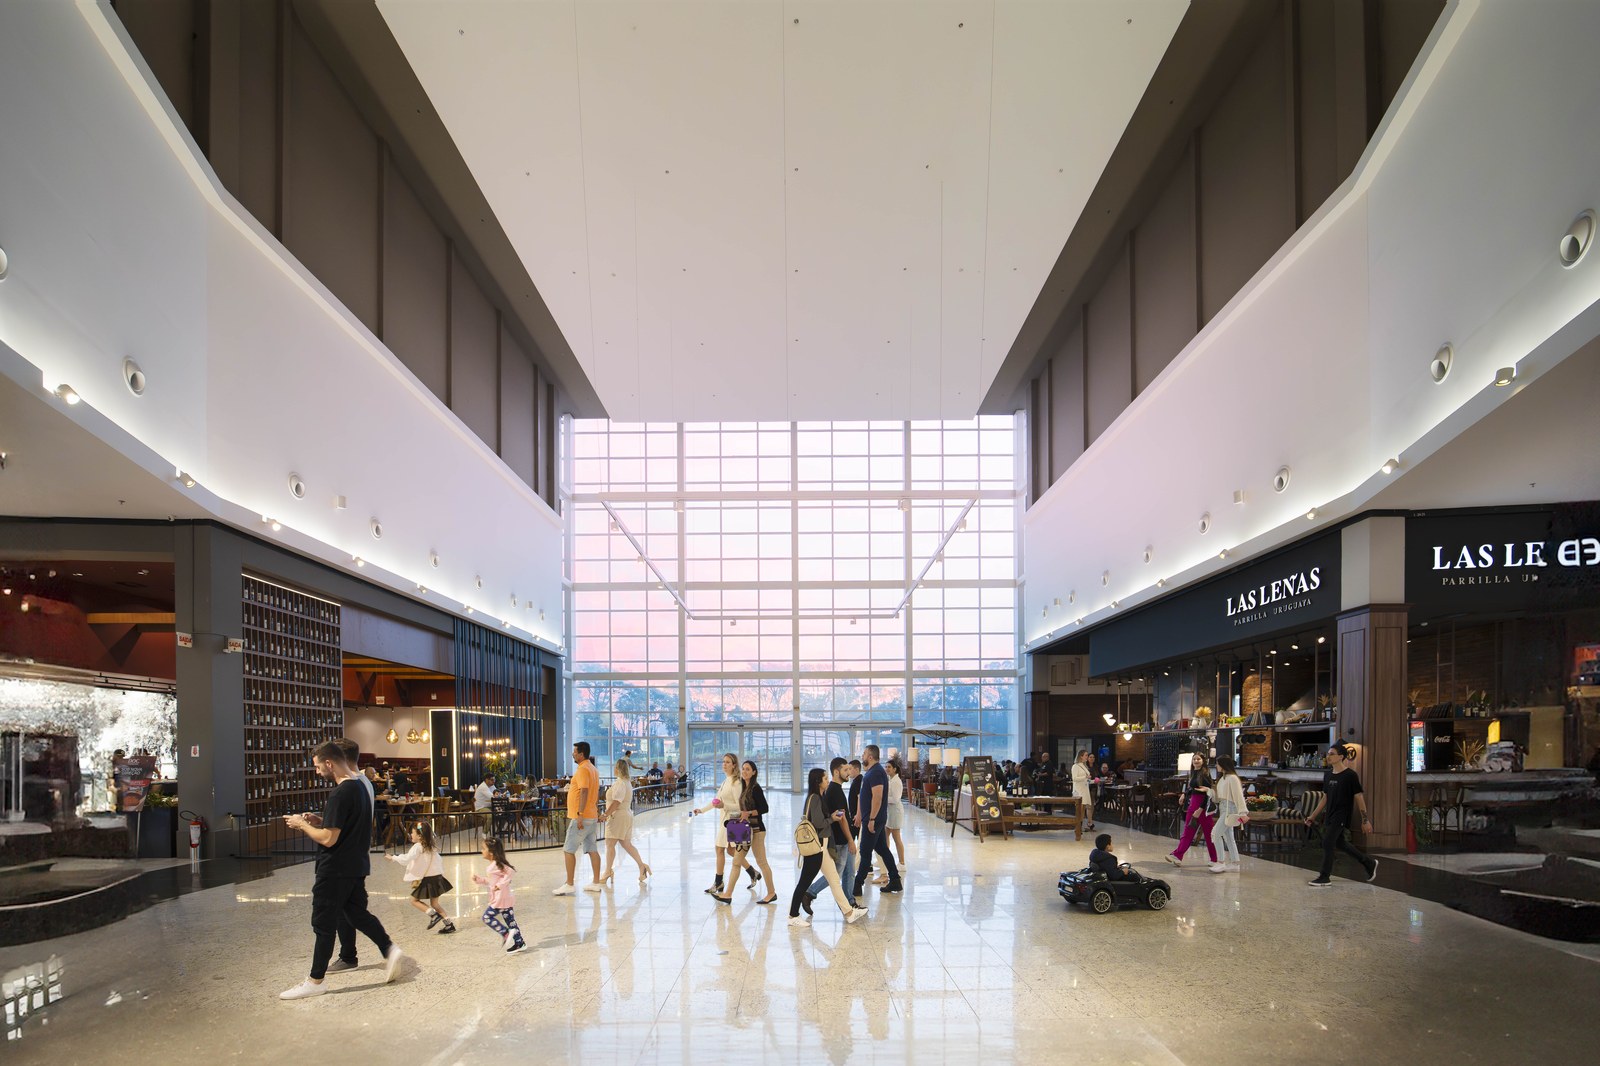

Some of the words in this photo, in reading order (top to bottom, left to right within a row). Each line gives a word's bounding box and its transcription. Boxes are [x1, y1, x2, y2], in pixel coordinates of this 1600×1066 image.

[1432, 544, 1494, 570] LAS
[1227, 590, 1256, 616] LAS
[1260, 567, 1320, 606] LEÑAS
[1442, 575, 1510, 586] PARRILLA
[1234, 612, 1267, 626] PARRILLA
[1273, 598, 1311, 615] URUGUAYA
